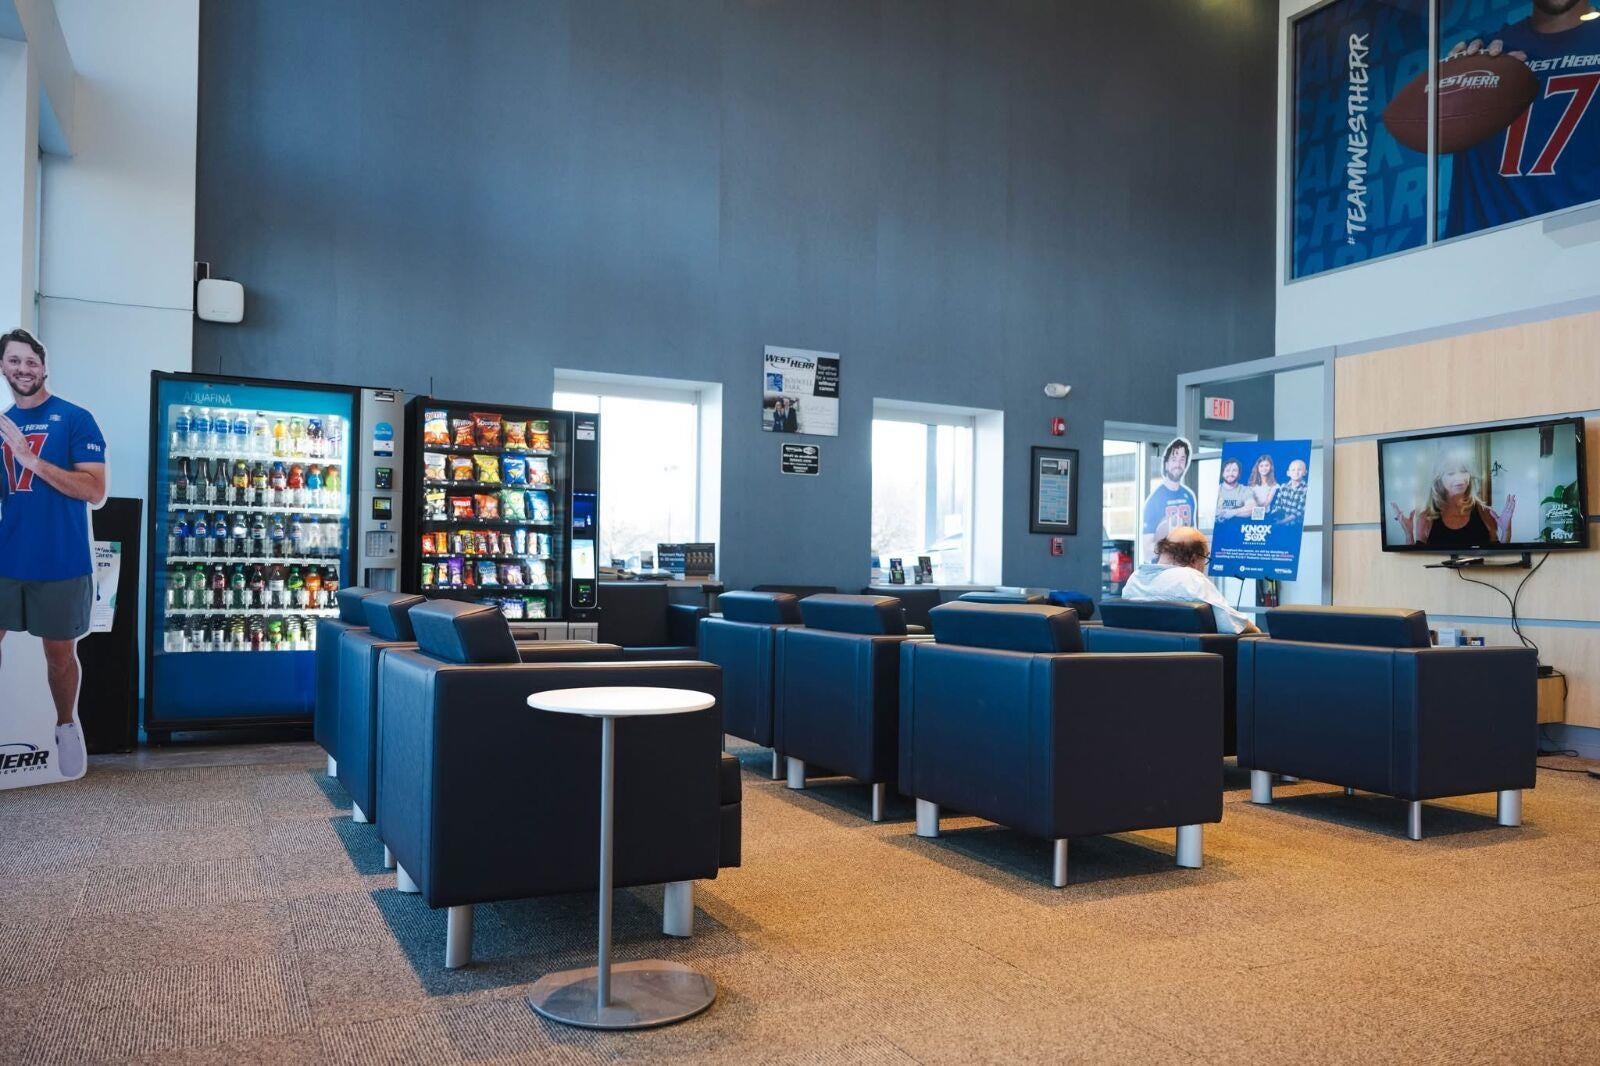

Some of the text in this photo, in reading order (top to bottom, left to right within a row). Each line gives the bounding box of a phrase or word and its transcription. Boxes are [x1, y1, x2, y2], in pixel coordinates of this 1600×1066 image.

[1430, 74, 1500, 91] EST HERR
[1498, 72, 1600, 177] 17
[1346, 32, 1369, 245] #TEAMWESTHERR
[765, 354, 815, 370] WEST HERR
[184, 391, 232, 405] AQUAFINA
[1213, 399, 1231, 419] EXIT
[86, 443, 101, 452] WH
[1240, 524, 1272, 534] KNOX
[1550, 530, 1574, 540] HGTV
[1243, 533, 1266, 542] SOX
[0, 751, 49, 769] ERR
